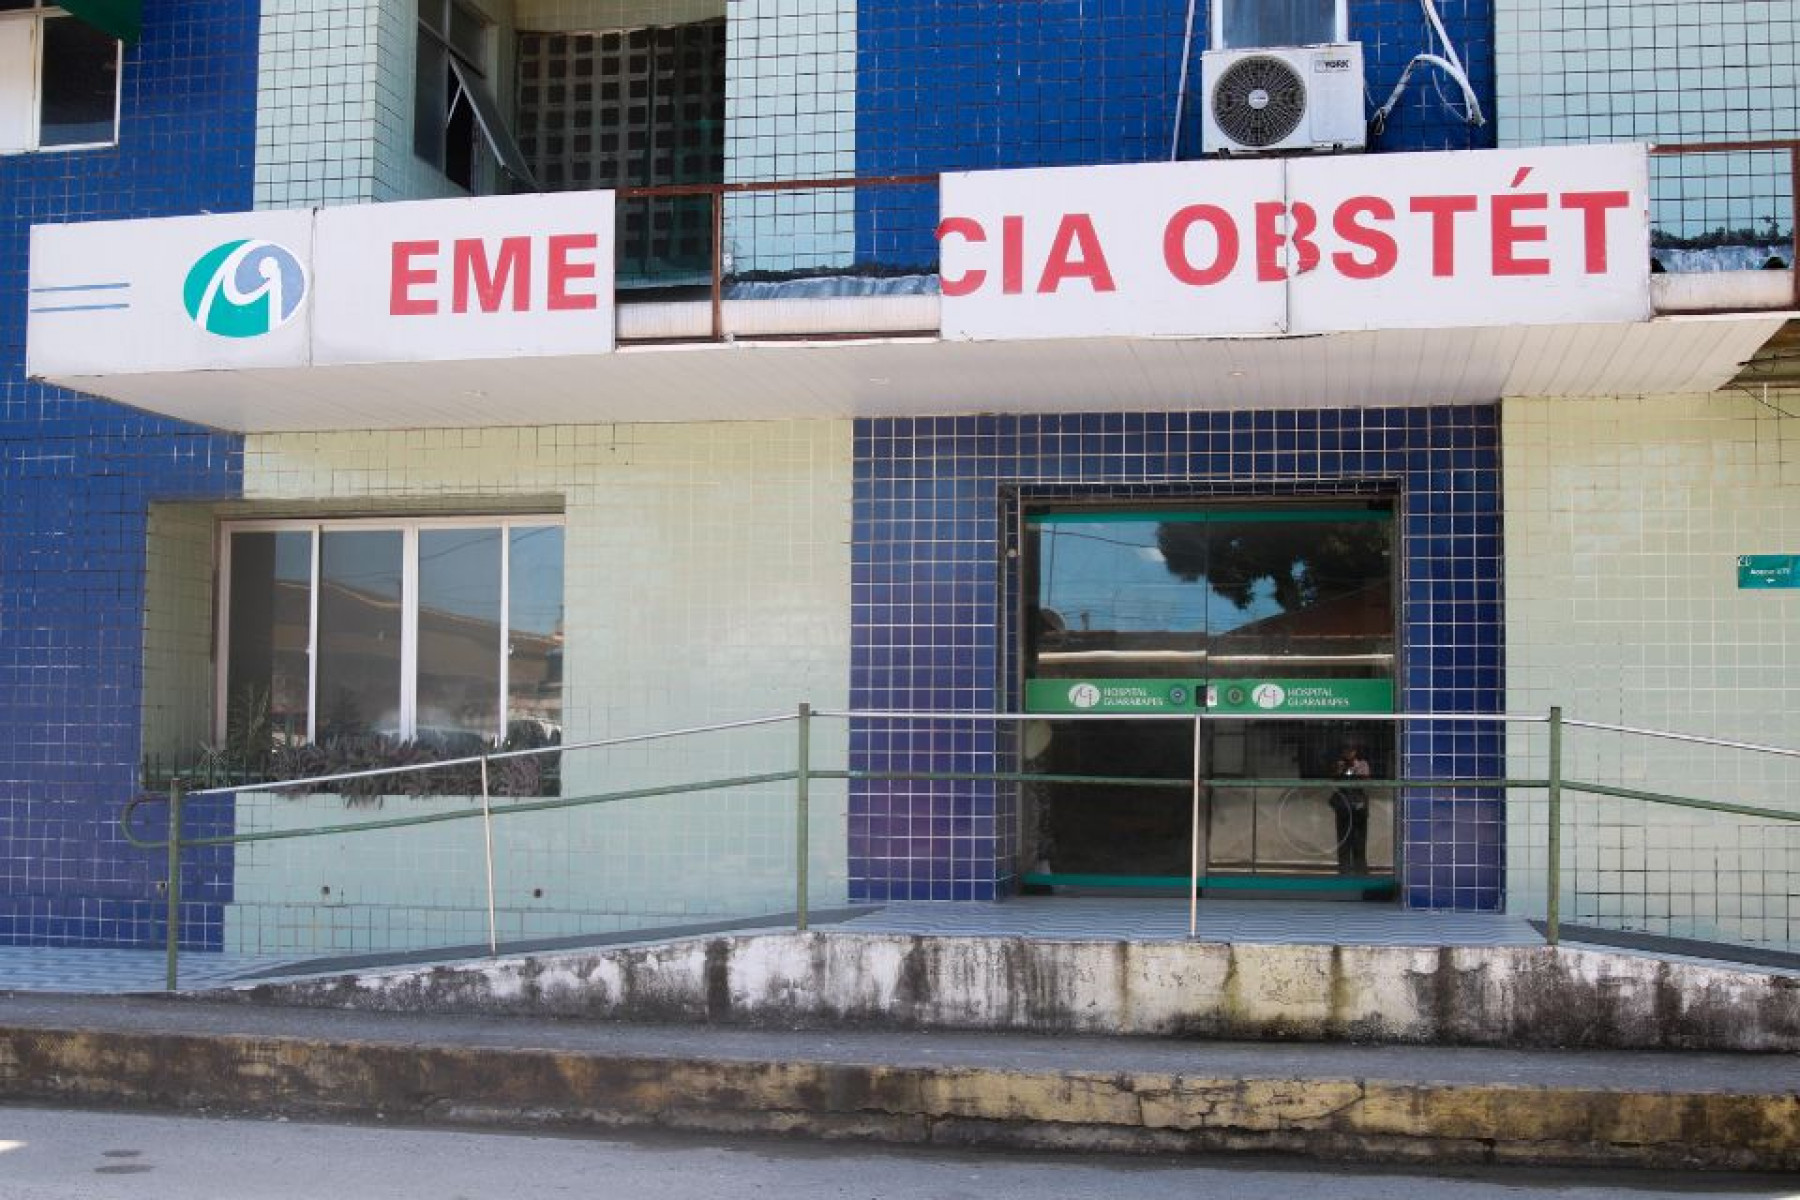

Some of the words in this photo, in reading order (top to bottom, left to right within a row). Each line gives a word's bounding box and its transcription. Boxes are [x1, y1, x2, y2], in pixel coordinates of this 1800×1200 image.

[390, 234, 598, 315] EME
[934, 214, 1115, 295] CIA
[1163, 167, 1629, 285] OBSTÉT
[1104, 687, 1146, 696] HOSPITAL
[1288, 687, 1332, 696] HOSPITAL
